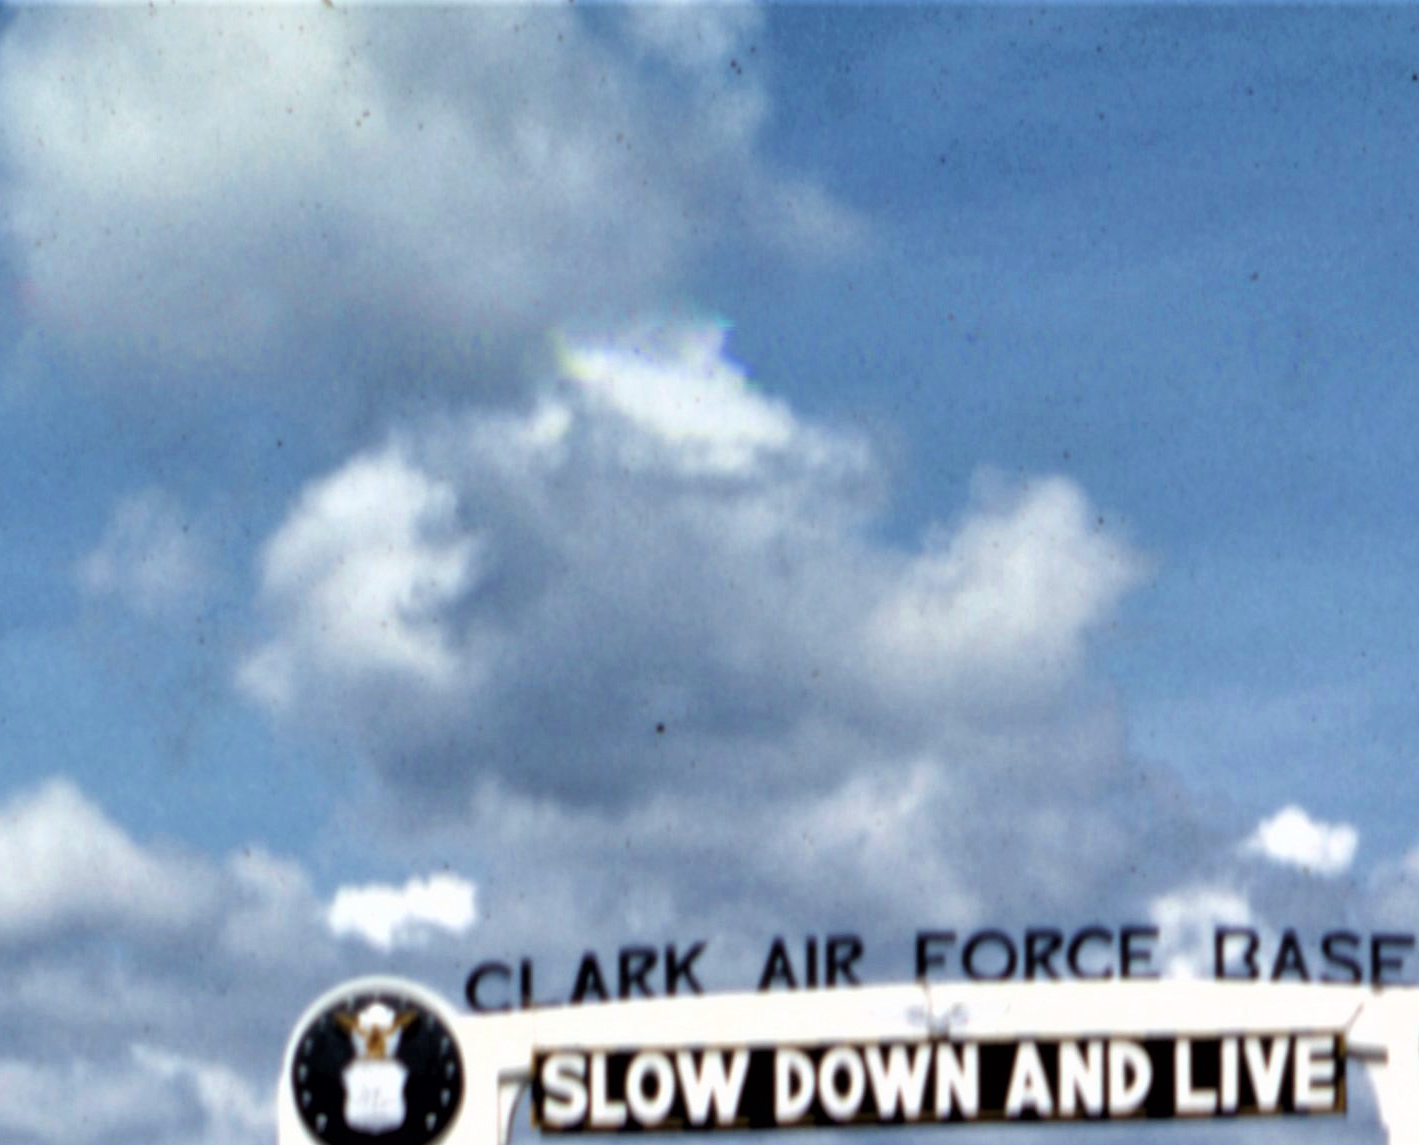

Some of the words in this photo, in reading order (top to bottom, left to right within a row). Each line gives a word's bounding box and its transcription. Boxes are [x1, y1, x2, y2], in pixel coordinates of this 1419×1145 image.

[465, 939, 709, 1014] CLARK
[757, 933, 865, 993] AIR
[915, 924, 1160, 983] FORCE
[1213, 926, 1416, 992] BASE
[540, 1046, 752, 1128] SLOW
[774, 1038, 980, 1126] DOWN
[1004, 1037, 1154, 1119] AND
[1175, 1033, 1338, 1115] LIVE
